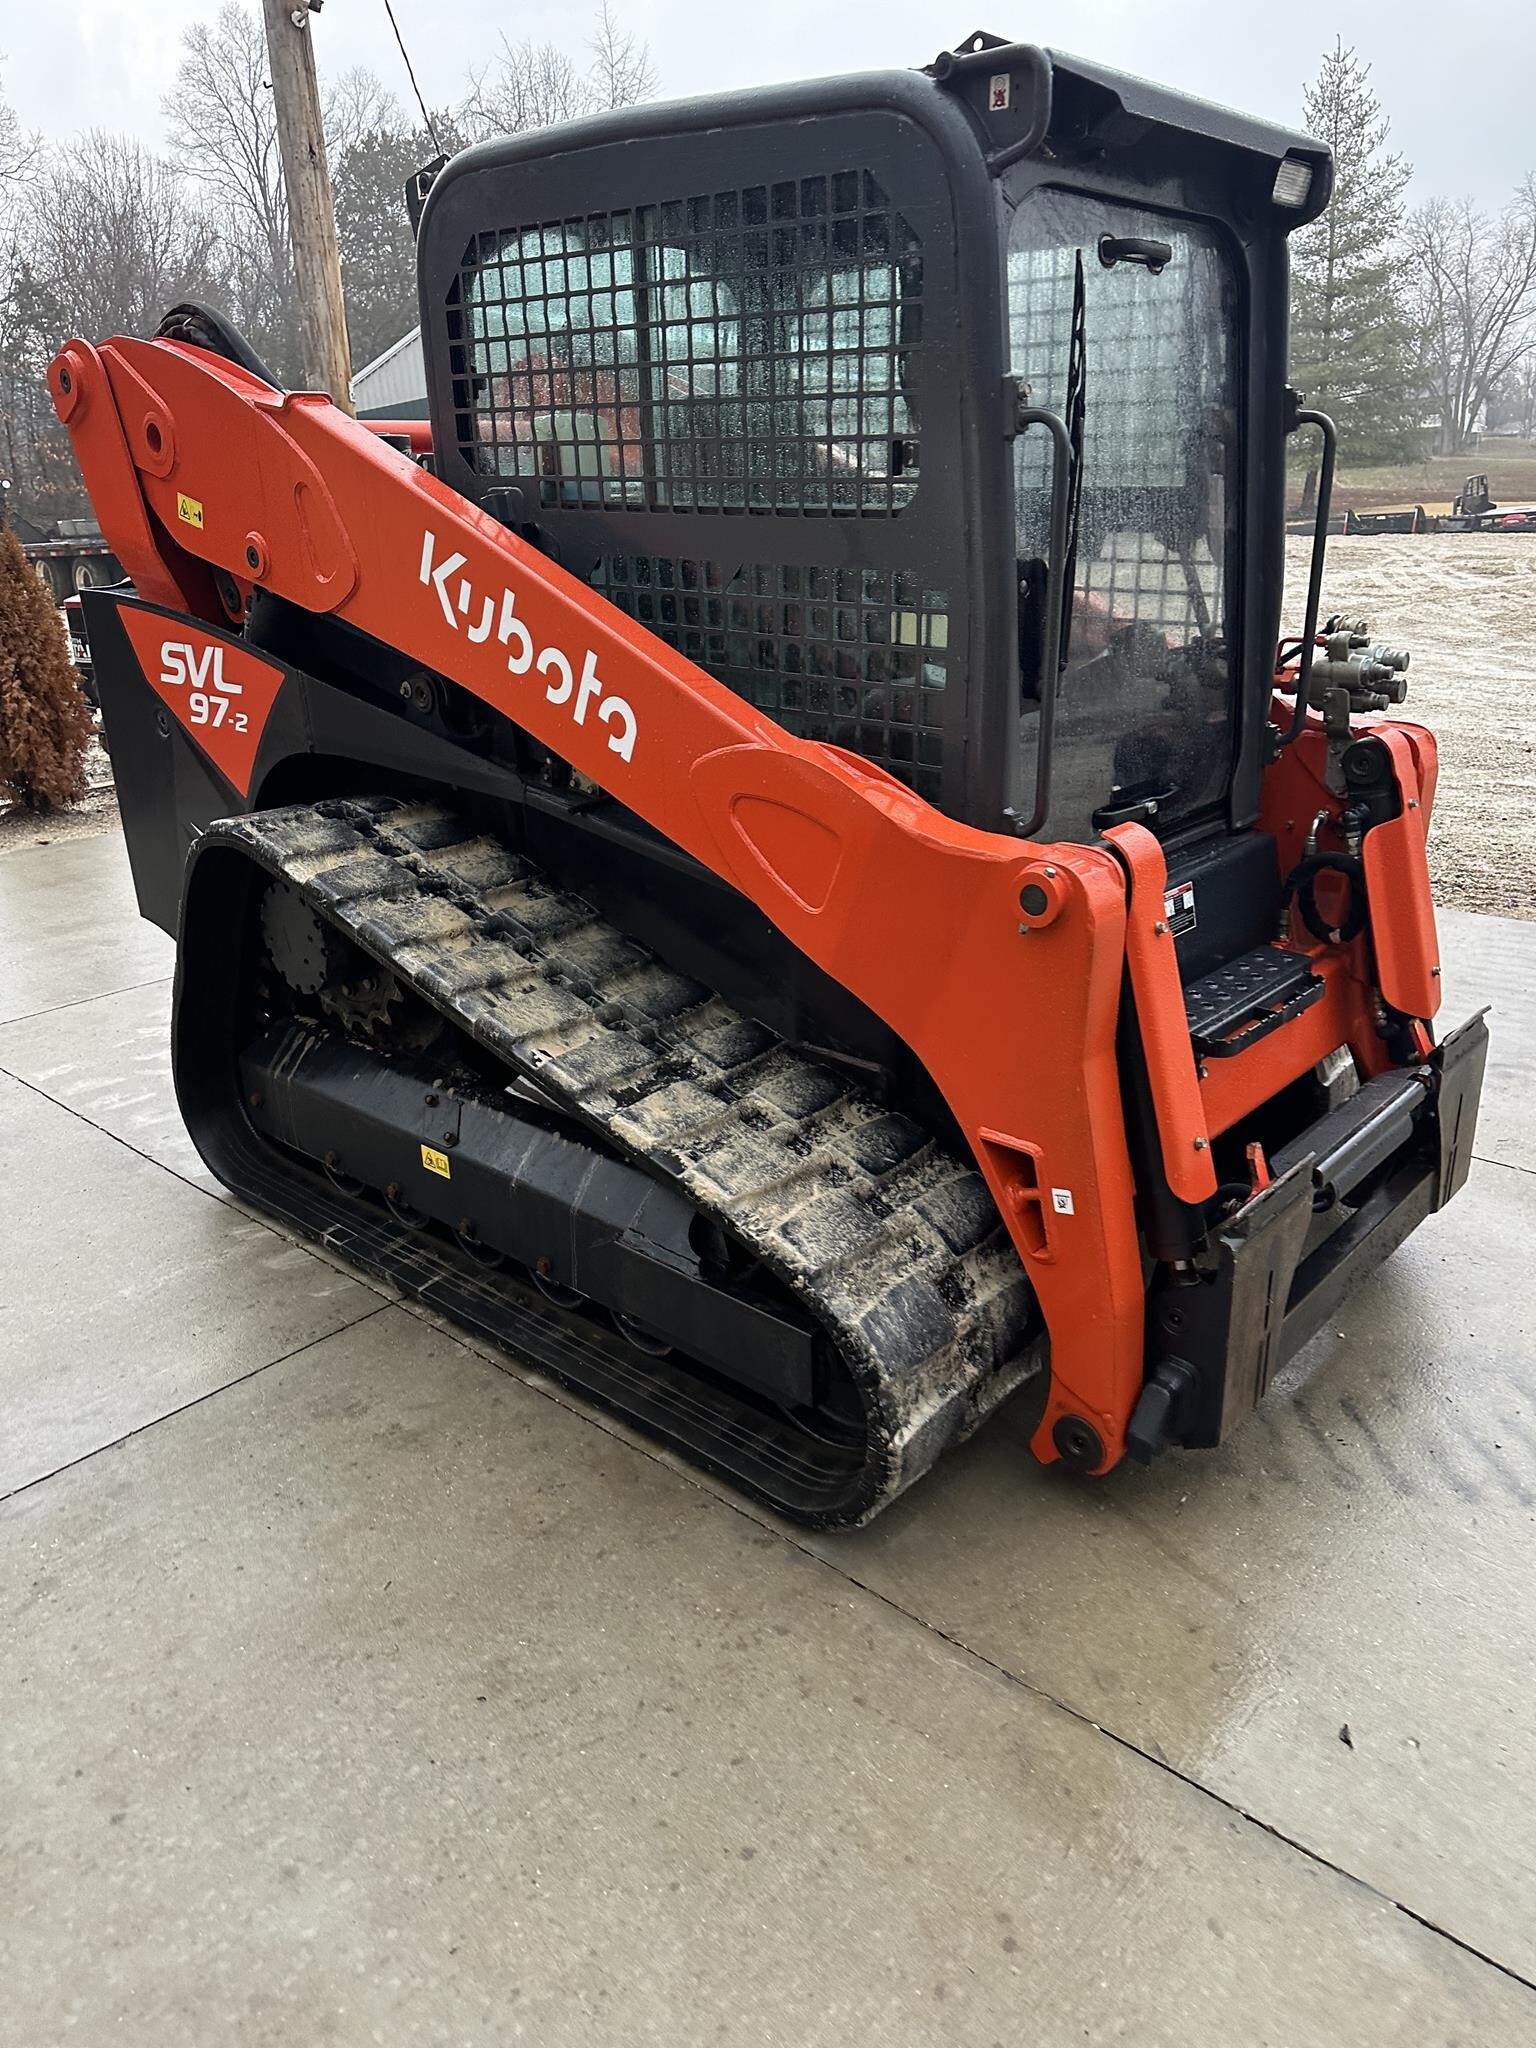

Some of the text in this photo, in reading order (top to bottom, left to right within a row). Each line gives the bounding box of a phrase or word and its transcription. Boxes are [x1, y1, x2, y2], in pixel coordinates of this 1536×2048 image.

[160, 641, 243, 694] SVL
[419, 529, 638, 763] Kubota
[189, 692, 248, 733] 97-2
